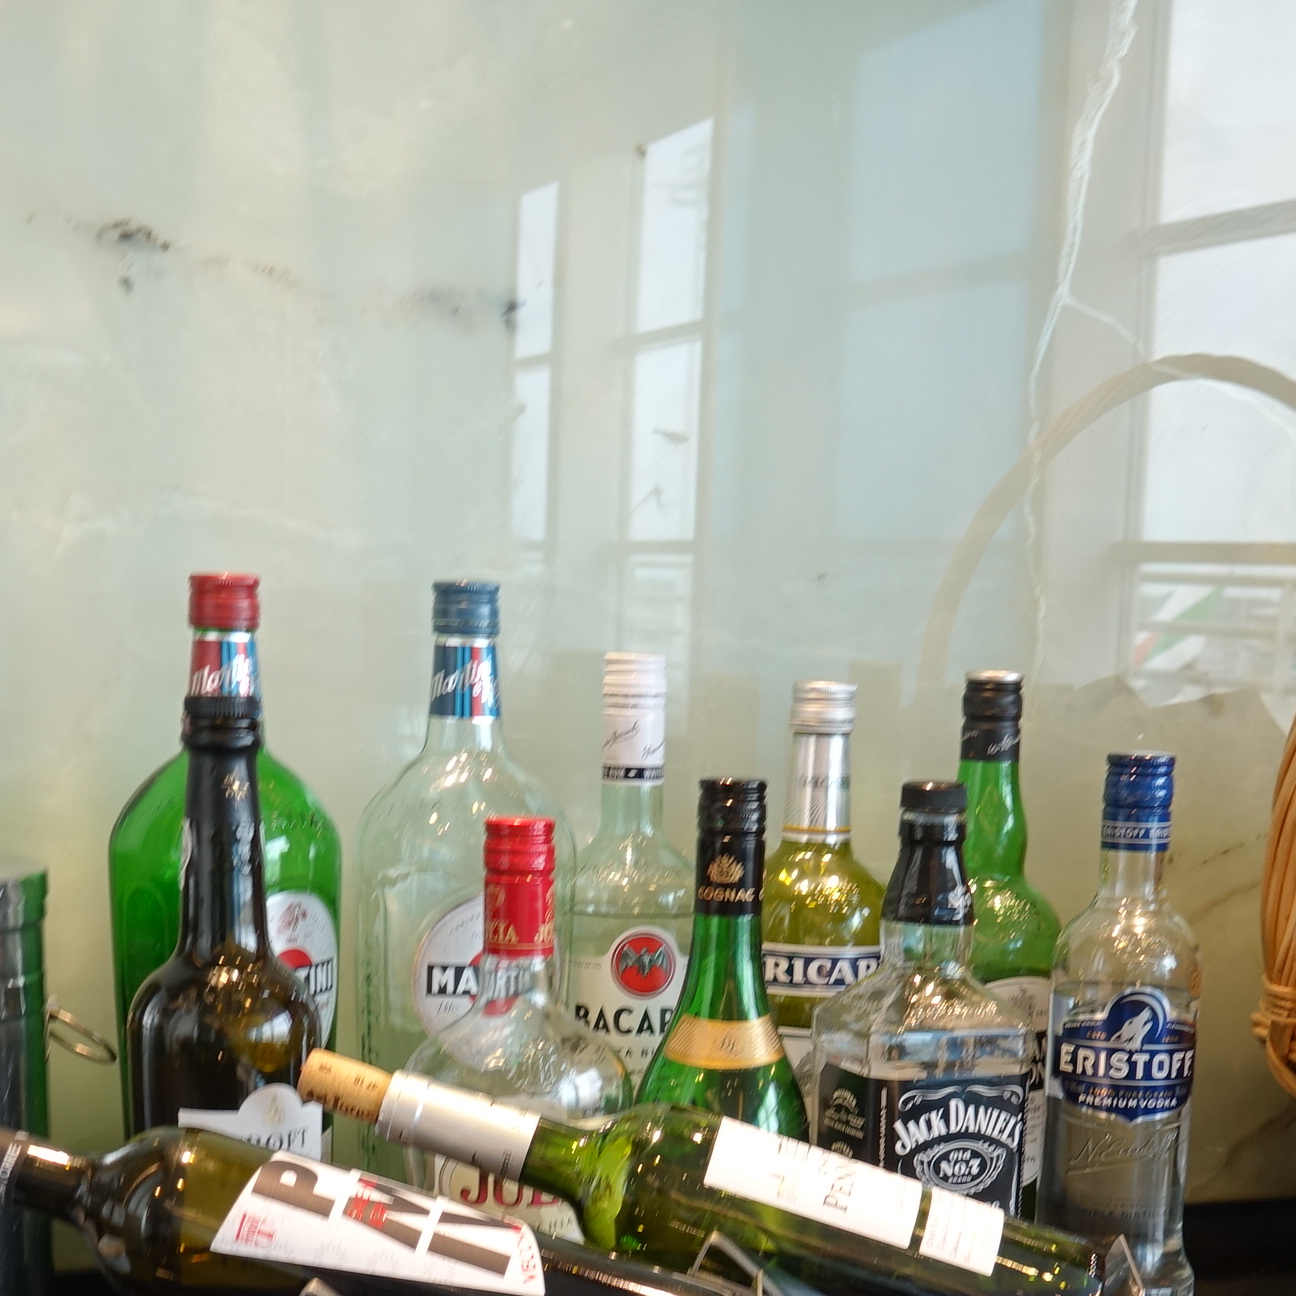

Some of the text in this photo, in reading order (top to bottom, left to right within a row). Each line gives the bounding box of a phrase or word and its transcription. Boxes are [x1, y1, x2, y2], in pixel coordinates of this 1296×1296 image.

[697, 885, 755, 903] COGNAC
[764, 954, 879, 985] RICAR
[1059, 1041, 1195, 1080] ERISTOFF
[1078, 1093, 1178, 1109] PREMIUM VODKA
[893, 1107, 948, 1156] JACK
[949, 1097, 1024, 1149] DANIEL'S
[950, 1149, 971, 1161] Old
[940, 1156, 981, 1178] No.7
